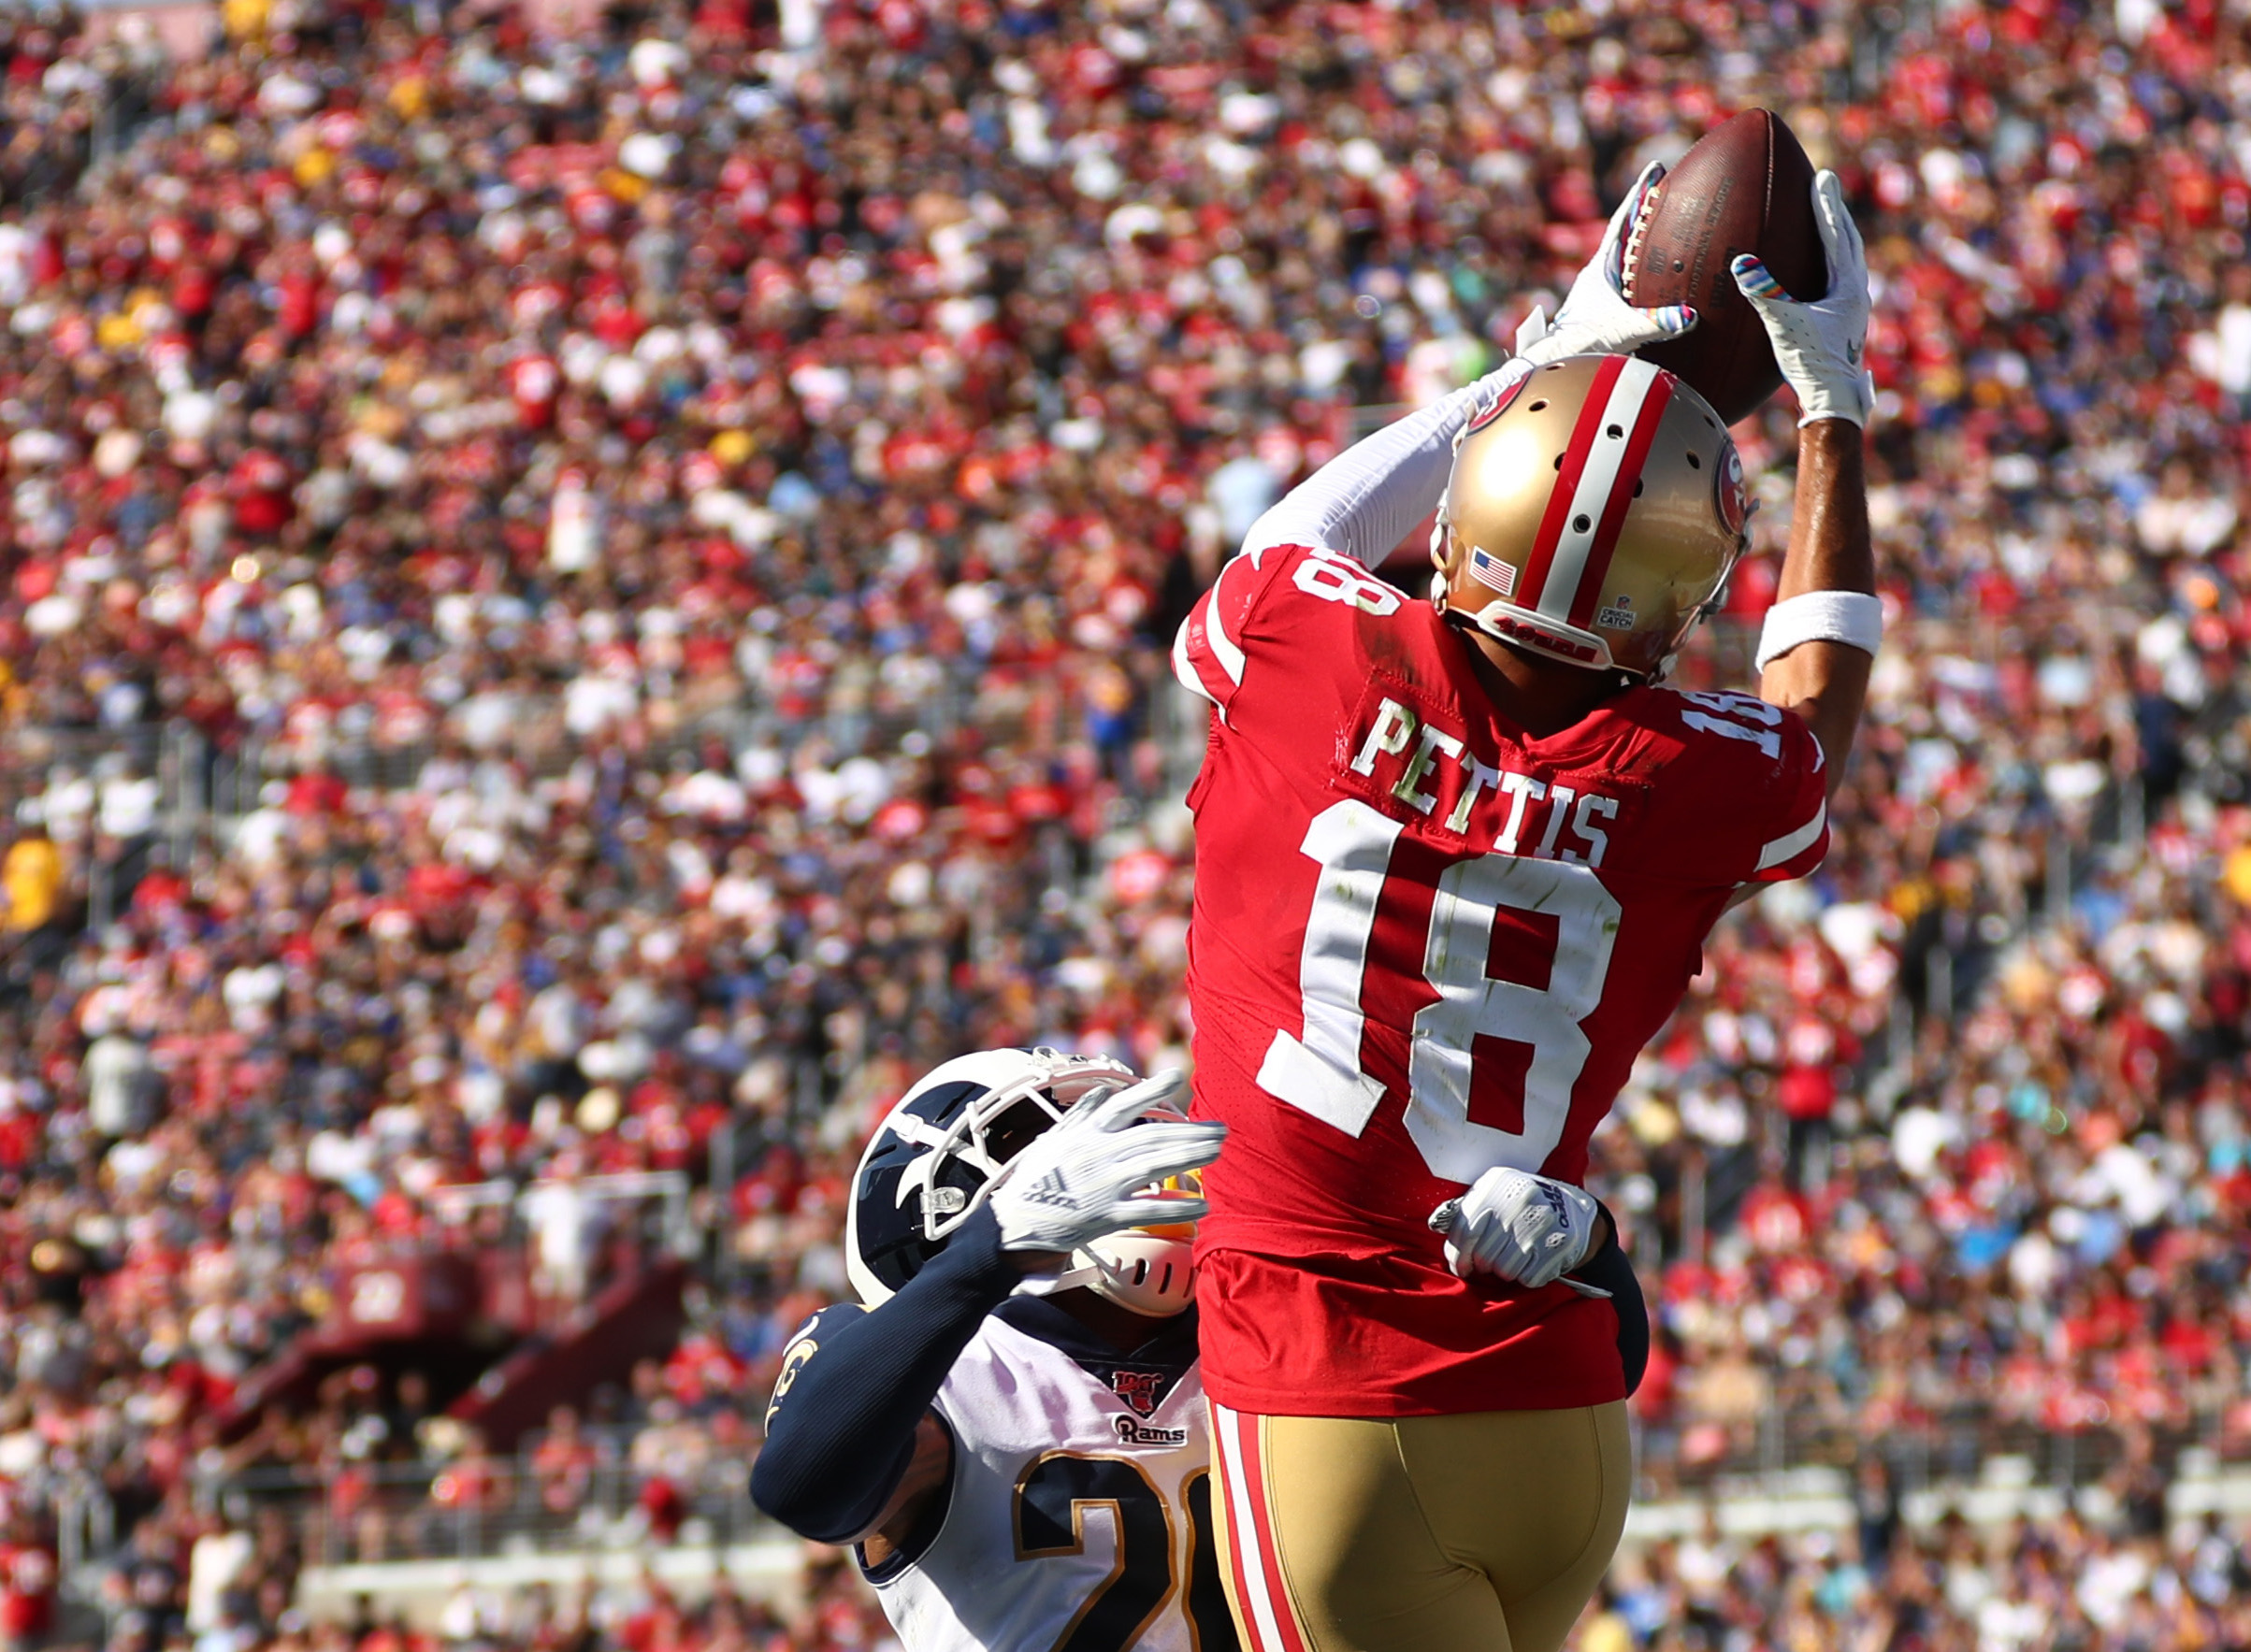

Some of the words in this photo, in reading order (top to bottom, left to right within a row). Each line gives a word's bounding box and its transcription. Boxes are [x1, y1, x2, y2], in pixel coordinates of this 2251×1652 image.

[1291, 546, 1411, 616] 18
[1599, 614, 1633, 627] CATCH
[1679, 690, 1782, 760] 18
[1350, 697, 1619, 869] PETTIS
[1256, 798, 1623, 1185] 18
[1114, 1414, 1186, 1445] Rams
